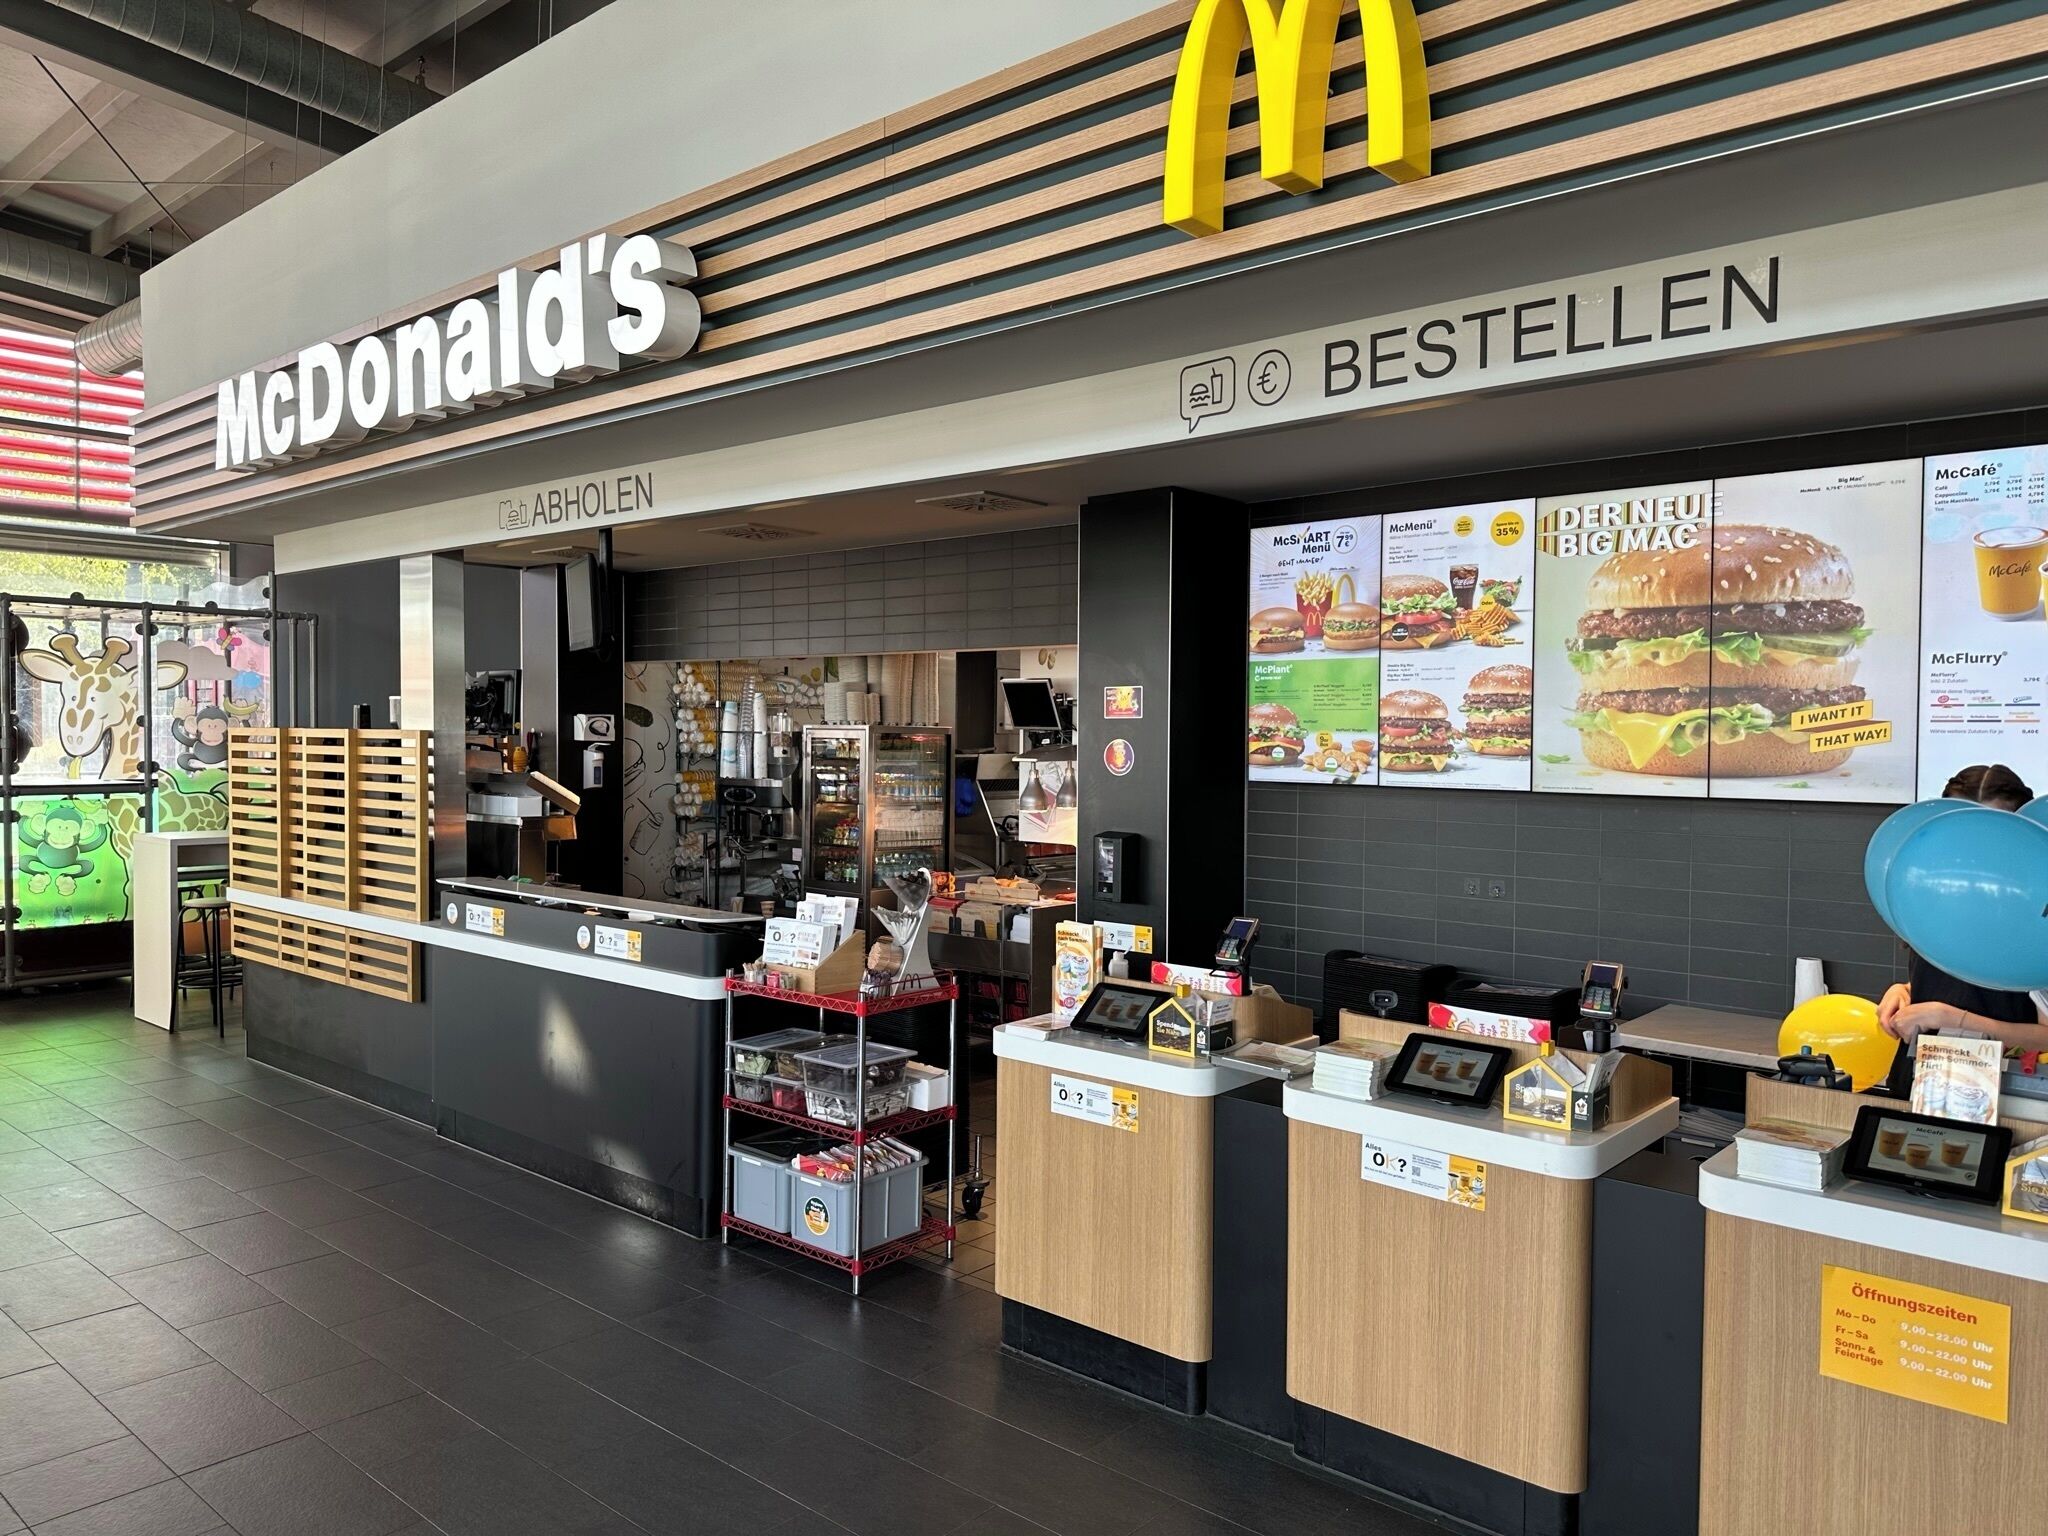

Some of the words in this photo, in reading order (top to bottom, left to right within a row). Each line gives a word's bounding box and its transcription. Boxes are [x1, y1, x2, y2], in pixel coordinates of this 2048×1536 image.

[1324, 256, 1780, 399] BESTELLEN
[215, 232, 668, 472] McDonald's
[532, 472, 653, 526] ABHOLEN
[1556, 502, 1622, 531] DER
[1630, 491, 1724, 525] NEUE
[1496, 527, 1520, 536] 35%
[1302, 542, 1331, 554] Menü
[1556, 530, 1613, 559] BIG
[1278, 558, 1294, 568] GEHT
[1800, 714, 1804, 725] I
[1808, 708, 1848, 724] WANT
[1851, 705, 1865, 716] IT
[1816, 734, 1850, 748] THAT
[1854, 728, 1888, 742] WAY!
[1922, 1043, 1971, 1058] Schmeckt
[1922, 1053, 1944, 1061] nach
[1946, 1055, 1992, 1068] Sommer-
[1365, 1142, 1382, 1152] Alles
[1851, 1282, 1978, 1325] Öffnungszeiten
[1836, 1308, 1852, 1318] Mo
[1862, 1314, 1876, 1324] Do
[1972, 1341, 1994, 1354] Uhr
[1835, 1338, 1866, 1351] Sonn-
[1868, 1346, 1876, 1354] &
[1836, 1325, 1846, 1334] Fr
[1856, 1330, 1869, 1340] Sa
[1972, 1358, 1994, 1372] Uhr
[1835, 1346, 1884, 1366] Feiertage
[1972, 1376, 1993, 1390] Uhr
